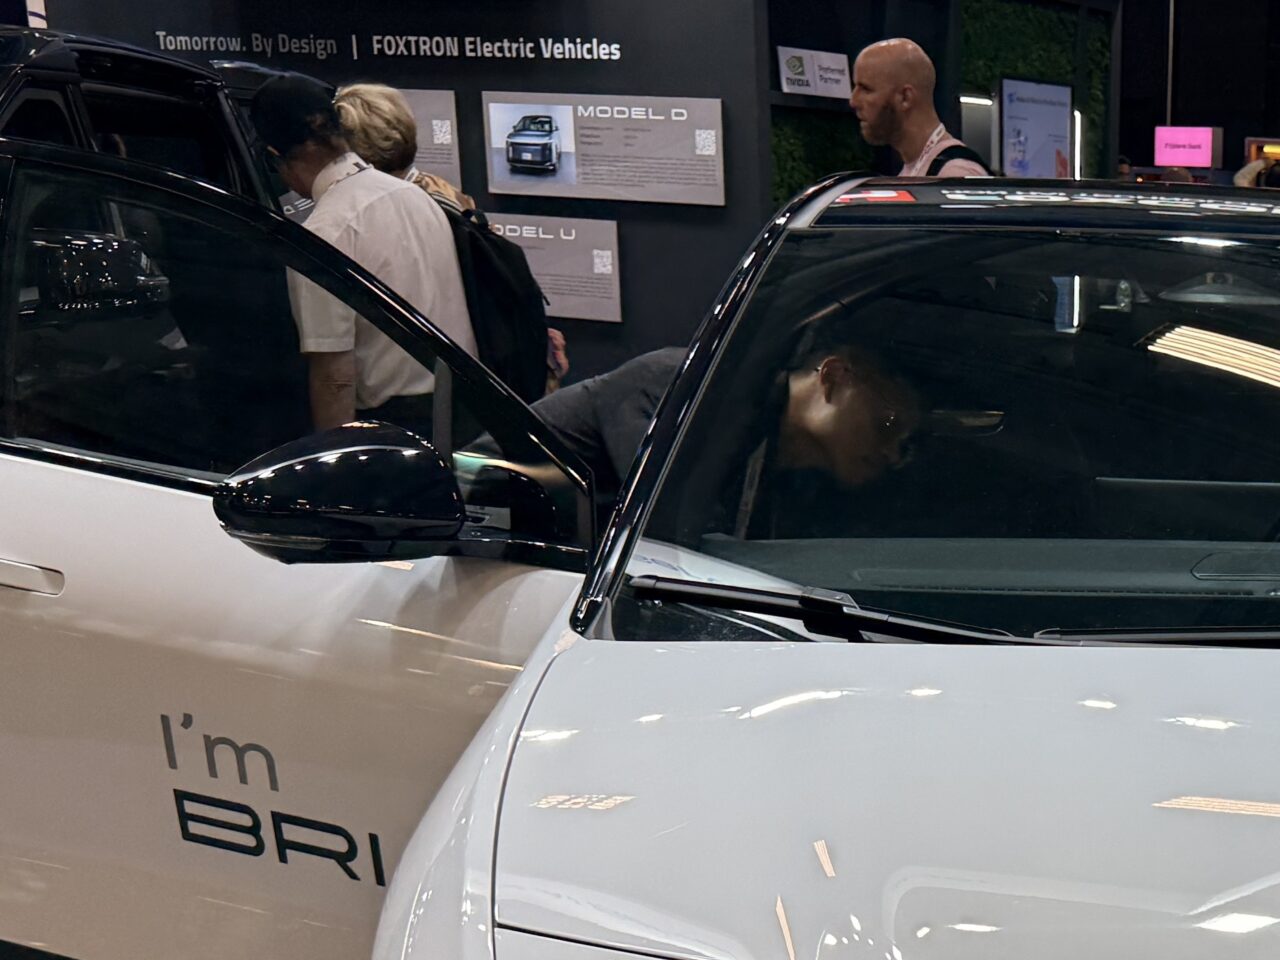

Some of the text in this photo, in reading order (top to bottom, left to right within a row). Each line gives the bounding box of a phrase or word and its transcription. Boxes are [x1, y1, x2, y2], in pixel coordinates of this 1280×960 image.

[155, 31, 621, 60] Tomorrow. By Design FOXTRON Electric Vehicles
[577, 105, 688, 120] MODEL D
[488, 222, 576, 239] ODEL U
[161, 712, 279, 792] I'm
